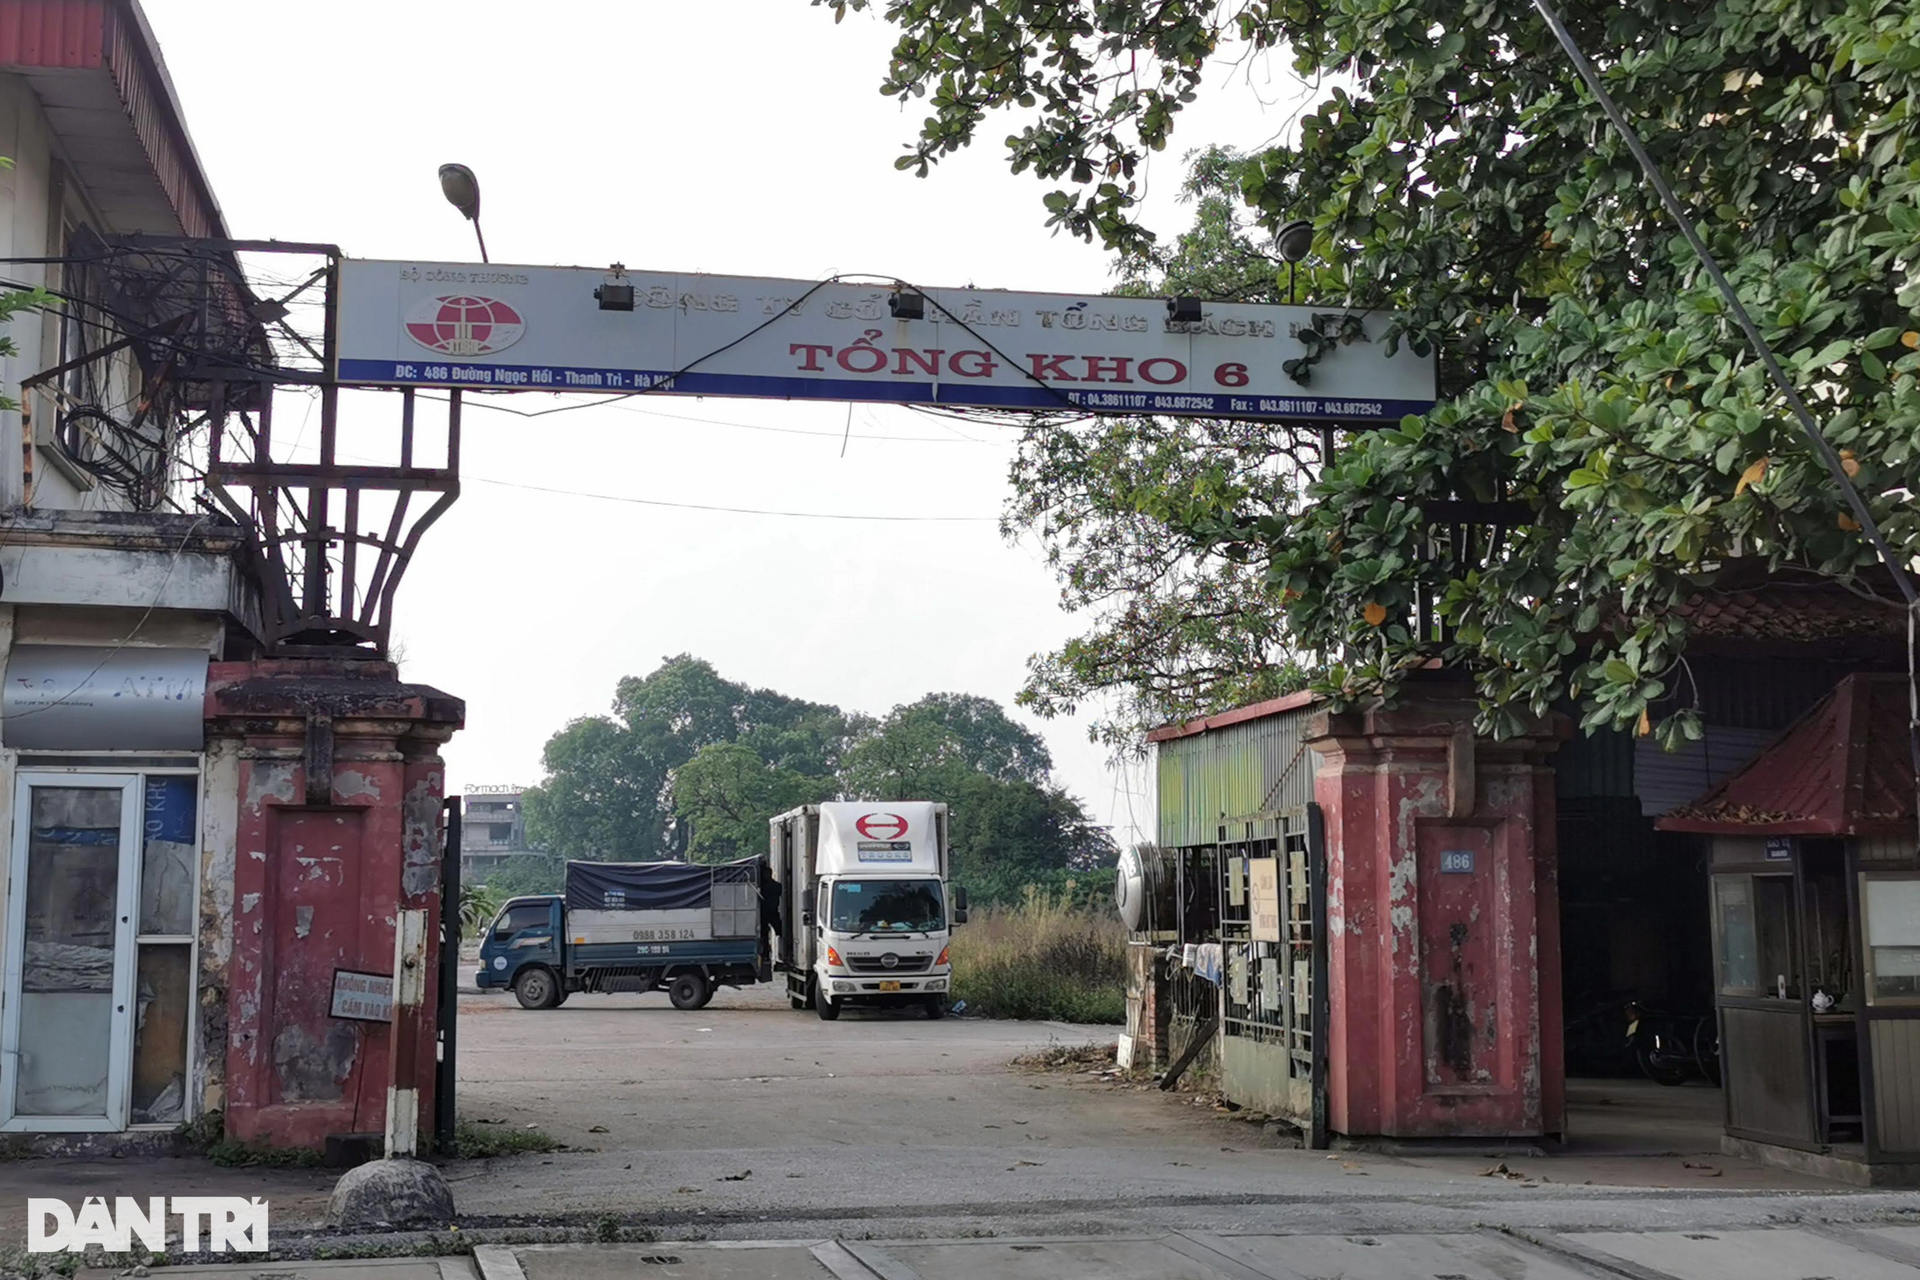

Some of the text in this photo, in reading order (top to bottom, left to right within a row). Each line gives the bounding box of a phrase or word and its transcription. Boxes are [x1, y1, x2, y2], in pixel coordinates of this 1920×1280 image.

[755, 295, 807, 316] TY
[926, 299, 1020, 328] HẦN
[1036, 302, 1149, 332] TỔNG
[789, 329, 1250, 388] TỔNG KHO 6
[424, 366, 448, 380] 486
[452, 366, 491, 383] Đường
[495, 368, 528, 385] Ngọc
[565, 371, 602, 386] Thanh
[606, 371, 623, 386] Trì
[634, 373, 650, 387] Hà
[1230, 398, 1247, 411] Fax
[1445, 854, 1470, 869] 486
[658, 930, 676, 940] 358
[679, 929, 695, 939] 124
